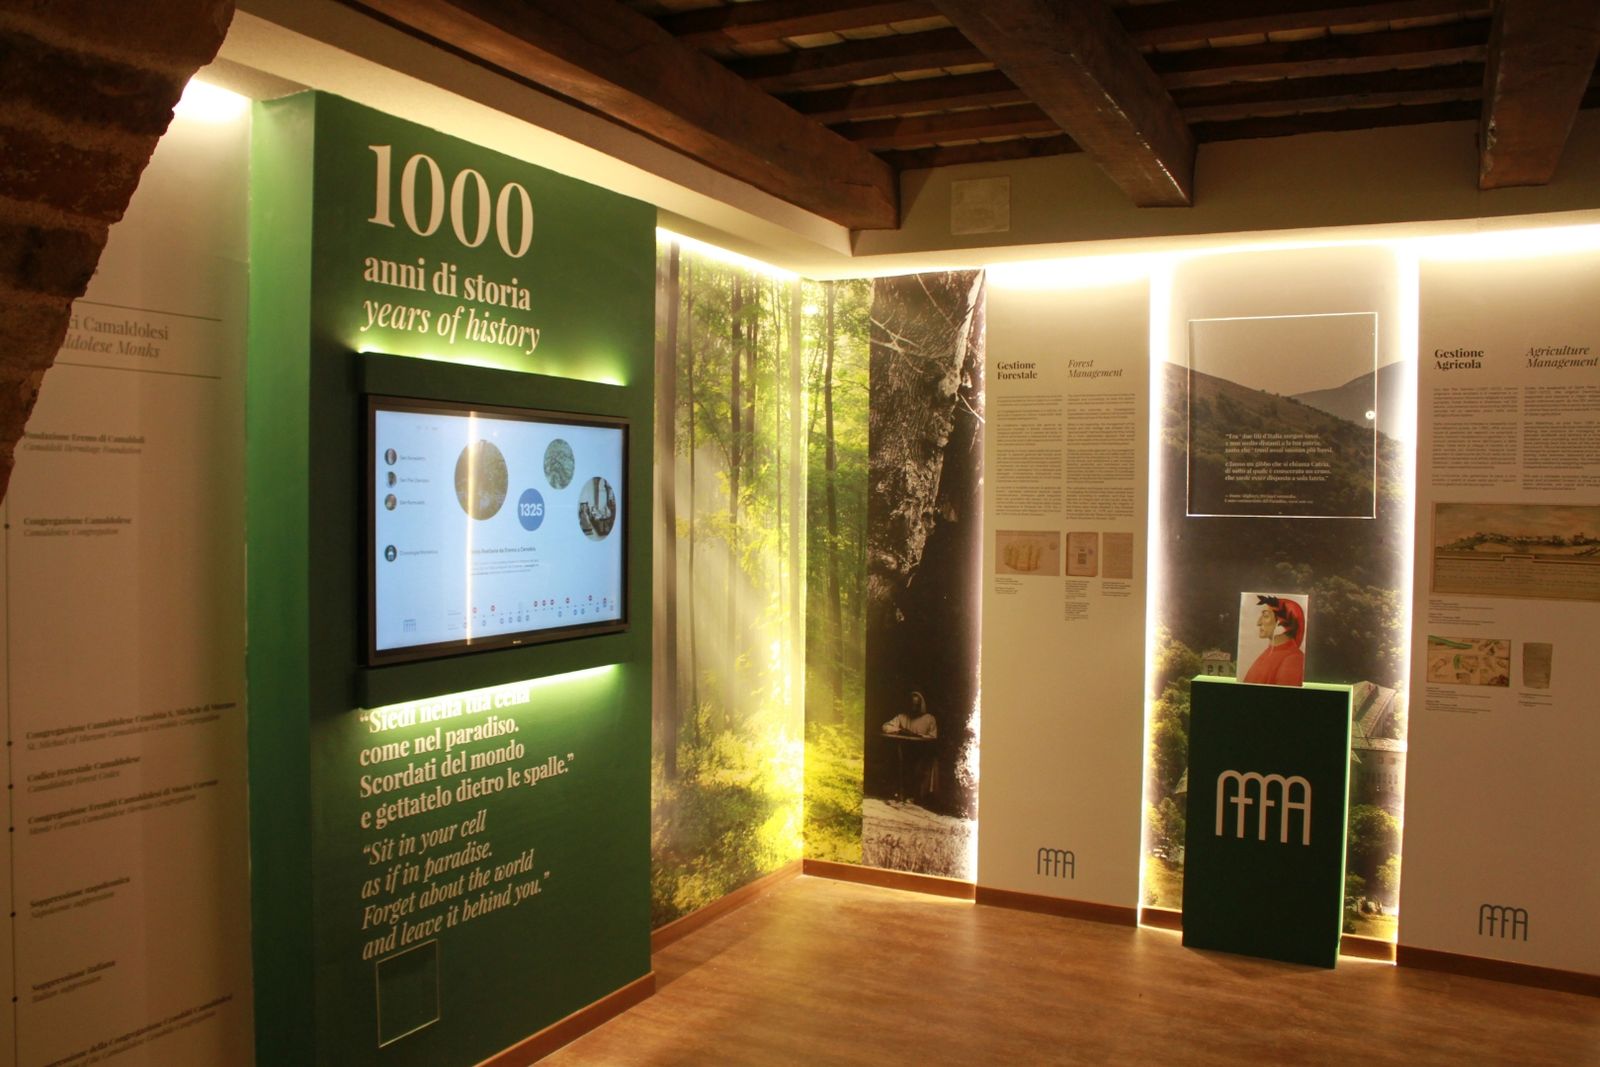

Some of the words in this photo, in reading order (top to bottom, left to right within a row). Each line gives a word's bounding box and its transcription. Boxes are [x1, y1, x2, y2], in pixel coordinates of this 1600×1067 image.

[368, 145, 534, 258] 1000
[364, 257, 426, 291] anni
[433, 262, 457, 297] di
[464, 275, 531, 310] storia
[84, 316, 168, 340] Camaldolesi
[360, 300, 431, 333] years
[437, 306, 464, 344] of
[465, 308, 540, 355] history
[63, 334, 112, 354] ldolese
[116, 340, 160, 358] Monks
[1434, 348, 1484, 358] Gestione
[1526, 345, 1590, 358] Agriculture
[998, 361, 1036, 370] Gestione
[998, 371, 1038, 380] Forestale
[1068, 360, 1094, 368] Forest
[1068, 369, 1122, 379] Management
[1434, 360, 1482, 371] Agricola
[1526, 357, 1598, 368] Management
[520, 503, 543, 517] 1325
[360, 704, 416, 733] “Siedi
[420, 698, 462, 723] nella
[466, 695, 491, 710] tua
[360, 740, 410, 766] come
[414, 727, 441, 755] nel
[445, 715, 520, 751] paradiso.
[360, 758, 437, 798] Scordati
[441, 752, 467, 778] del
[470, 740, 525, 770] mondo
[361, 811, 371, 828] e
[376, 785, 452, 829] gettatelo
[456, 774, 504, 803] dietro
[507, 766, 521, 789] le
[524, 752, 575, 787] spalle.”
[363, 838, 395, 865] “Sit
[398, 832, 416, 857] in
[418, 824, 457, 854] your
[460, 809, 488, 838] cell
[362, 876, 380, 899] as
[385, 864, 402, 895] if
[402, 860, 420, 888] in
[424, 841, 493, 884] paradise.
[362, 890, 416, 930] Forget
[419, 876, 464, 912] about
[468, 868, 490, 894] the
[494, 849, 535, 882] world
[362, 926, 398, 960] and
[400, 914, 442, 947] leave
[446, 905, 458, 929] it
[462, 884, 511, 921] behind
